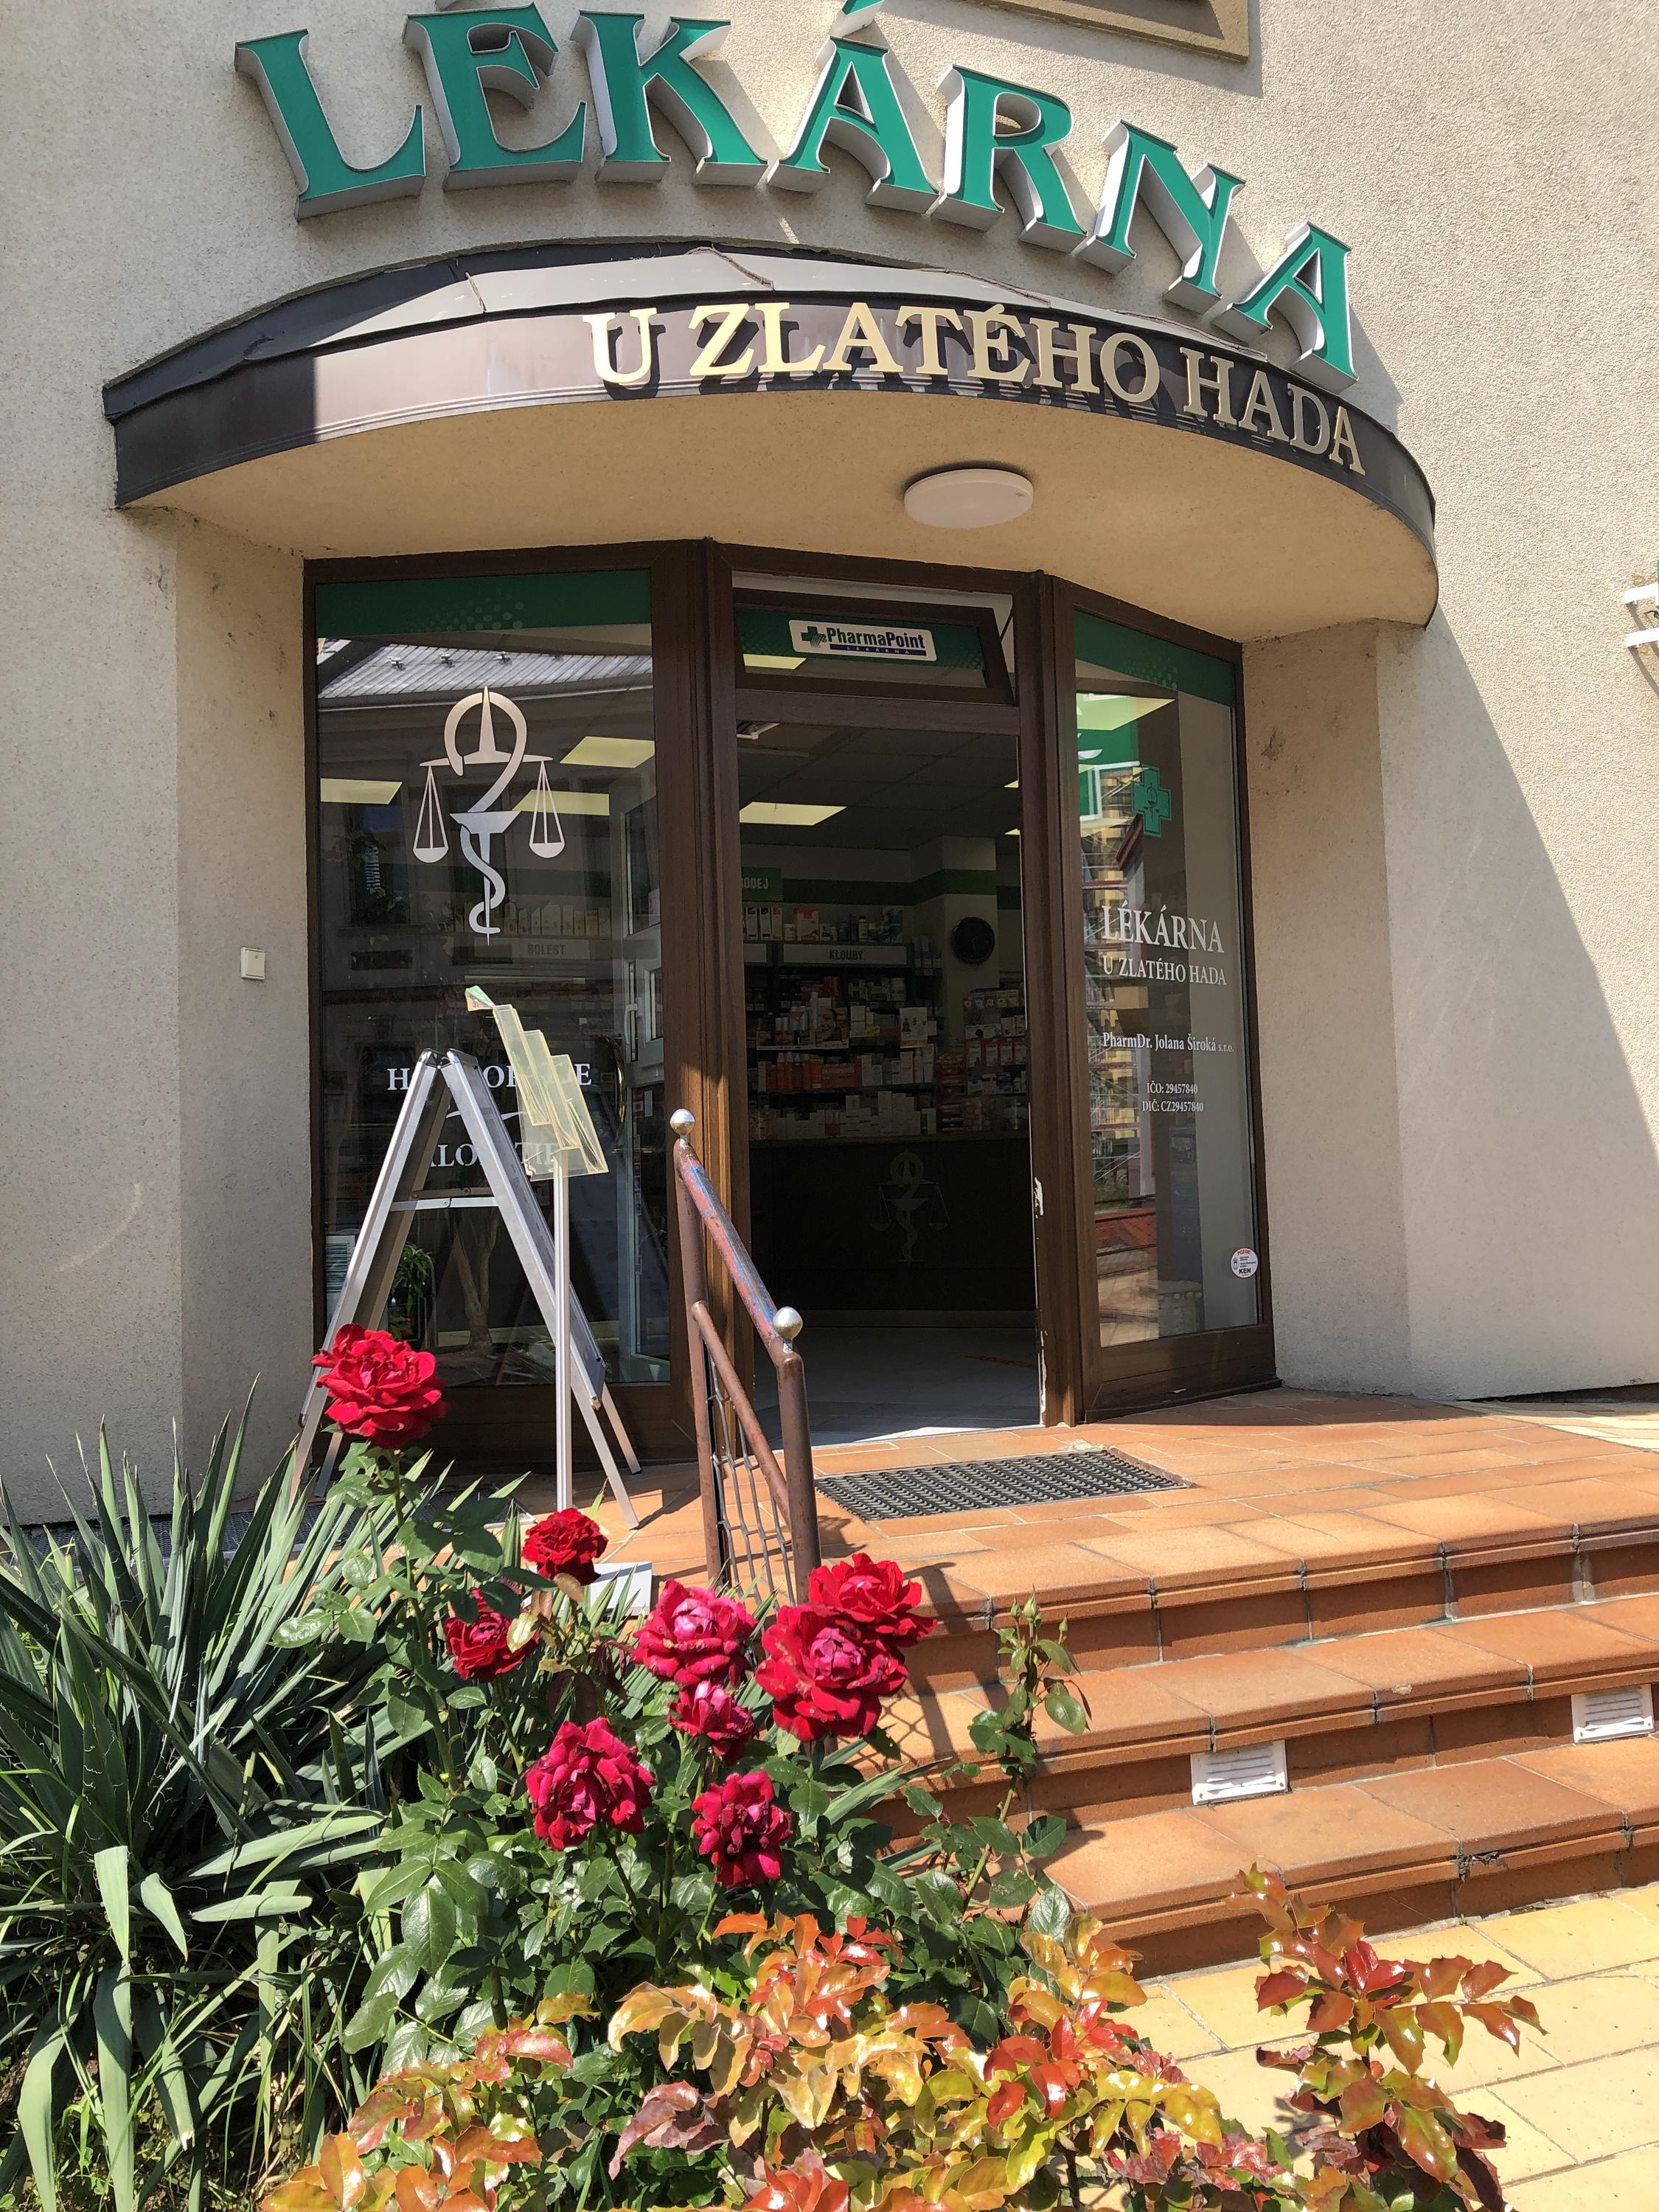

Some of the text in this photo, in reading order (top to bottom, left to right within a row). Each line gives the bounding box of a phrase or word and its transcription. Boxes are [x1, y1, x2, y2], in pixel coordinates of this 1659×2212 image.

[582, 302, 1366, 476] U ZLATÉHO HADA
[826, 627, 925, 649] PharmaPoint
[1101, 900, 1225, 953] LÉKÁRNA
[527, 943, 566, 956] BOLEST
[829, 949, 863, 961] KLOUBY
[1103, 956, 1227, 986] U ZLATÉHO HADA
[1103, 1032, 1152, 1049] PharmDr.
[1155, 1034, 1185, 1051] Jolana
[1187, 1033, 1216, 1052] Široká
[1165, 1082, 1198, 1094] 29457840
